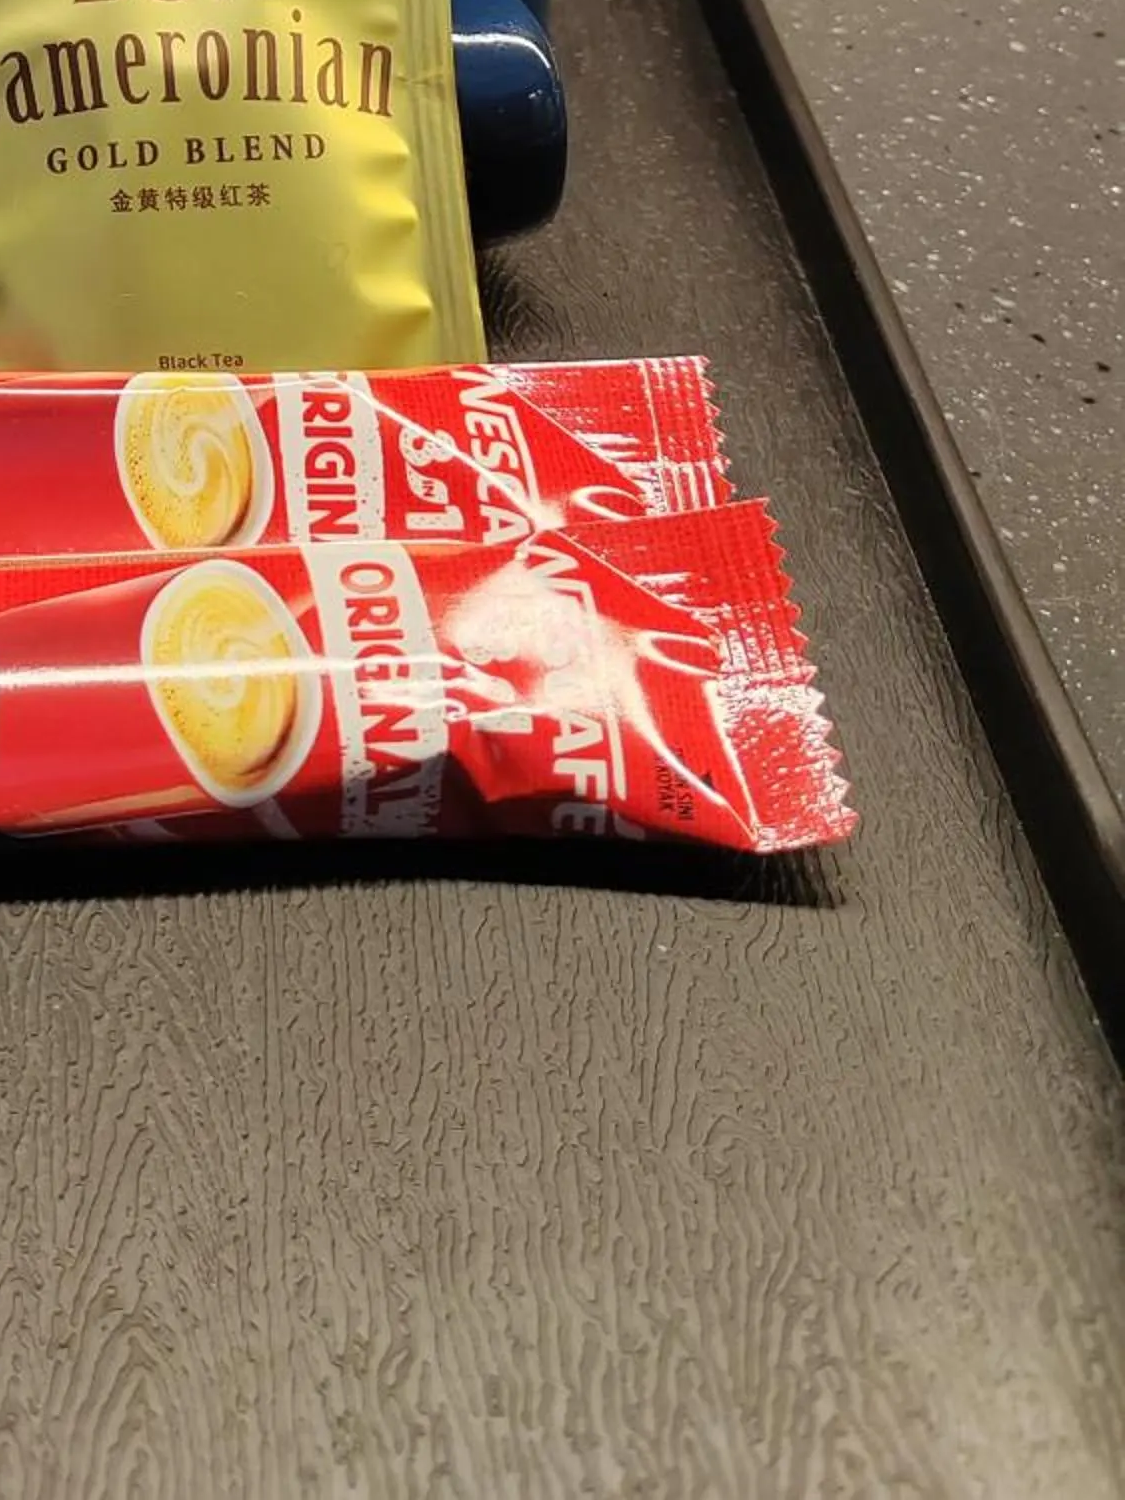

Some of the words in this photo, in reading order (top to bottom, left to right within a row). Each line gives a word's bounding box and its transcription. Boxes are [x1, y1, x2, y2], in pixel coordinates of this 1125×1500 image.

[47, 139, 160, 175] GOLD
[186, 132, 327, 166] BLEND
[109, 182, 272, 214] 金黄特级红茶
[158, 354, 208, 370] Black
[212, 352, 244, 369] Tea
